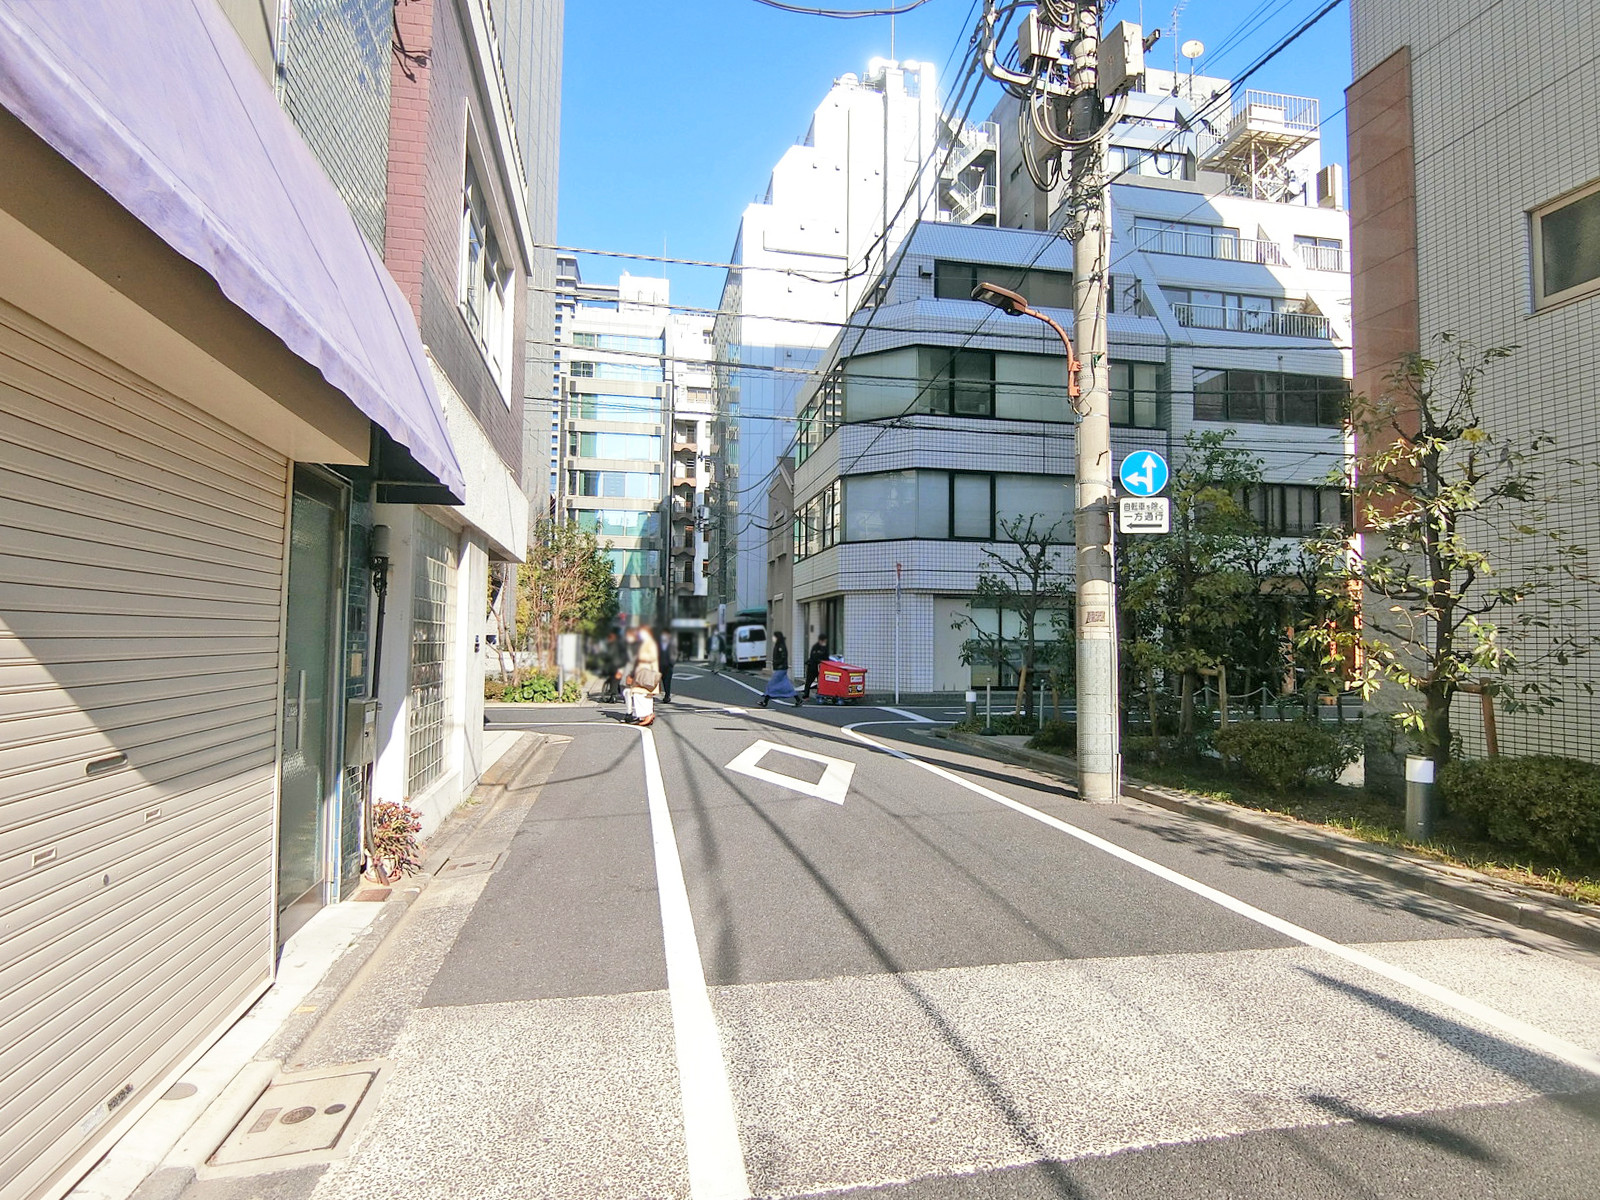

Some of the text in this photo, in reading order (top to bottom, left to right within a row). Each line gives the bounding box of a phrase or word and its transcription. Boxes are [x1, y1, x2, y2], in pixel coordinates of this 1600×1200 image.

[1124, 502, 1163, 511] 自転車を除く
[1124, 512, 1163, 521] 一方通行
